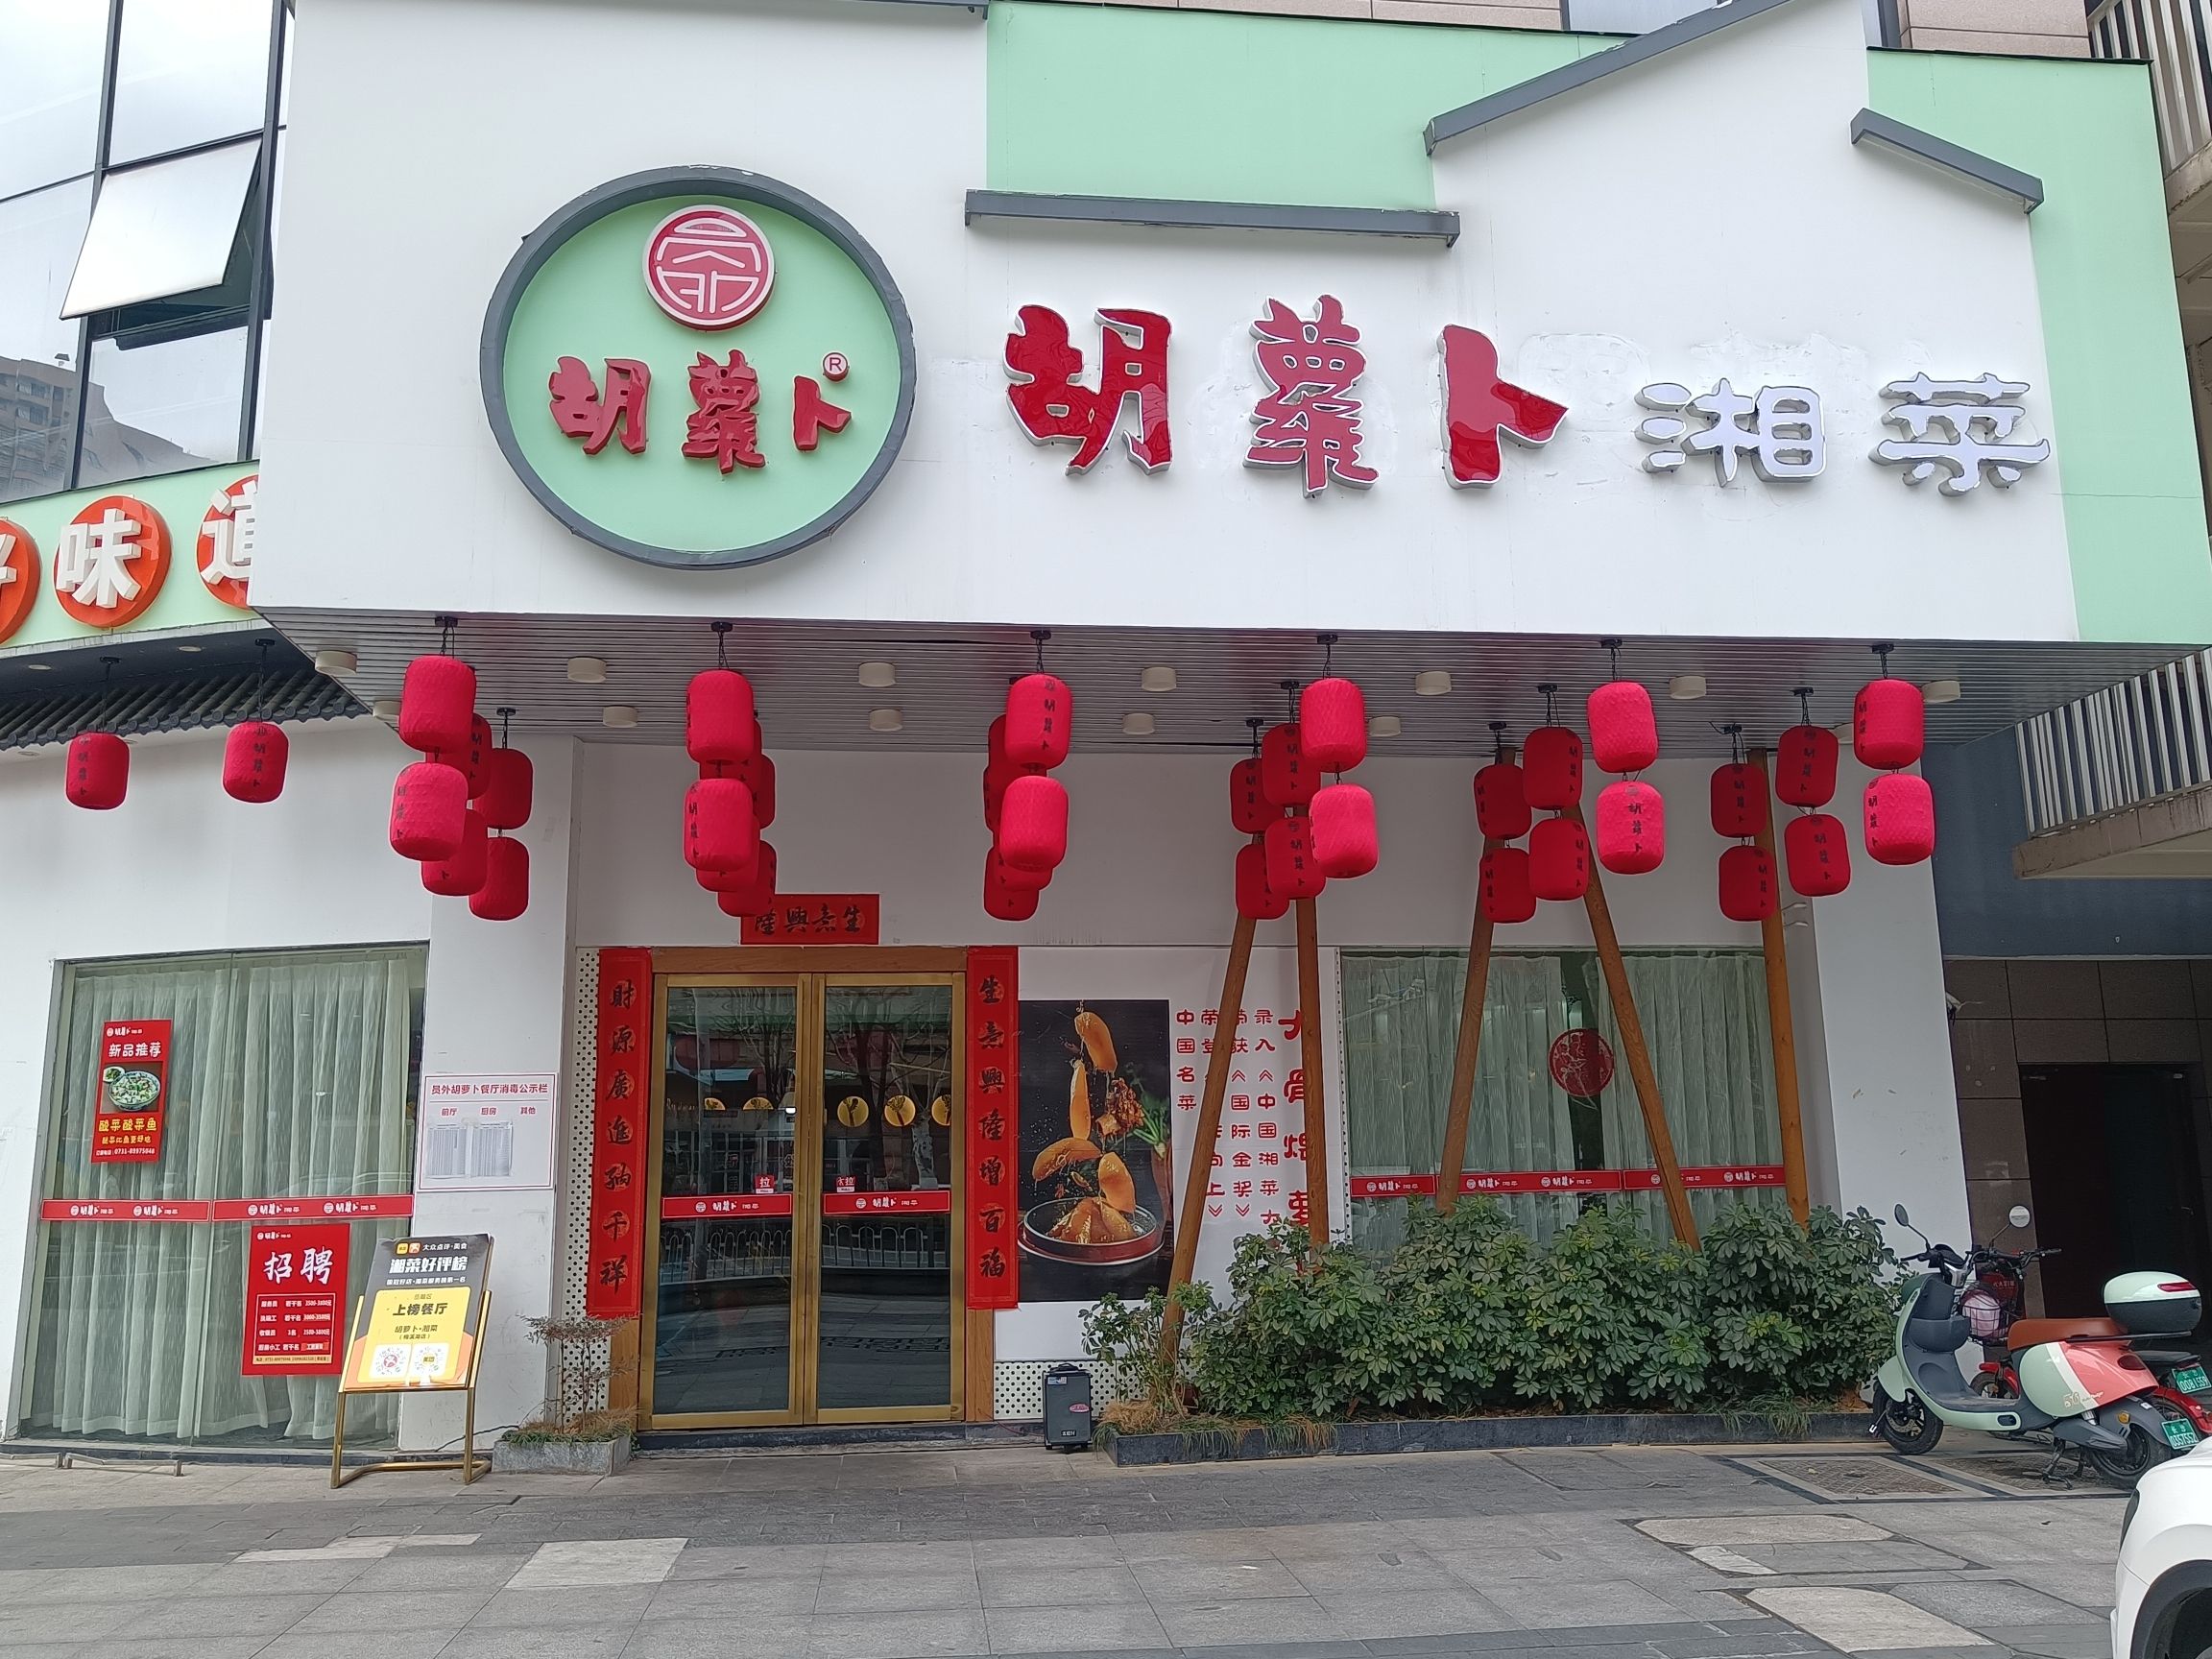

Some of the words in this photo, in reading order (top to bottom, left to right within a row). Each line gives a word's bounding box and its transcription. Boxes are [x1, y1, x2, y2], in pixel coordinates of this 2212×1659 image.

[1634, 372, 2050, 496] 湘菜
[108, 1042, 161, 1057] 新品推荐
[1176, 1009, 1196, 1111] 中国名菜
[431, 1083, 548, 1094] 员外胡萝卜餐厅消毒公示栏
[442, 1108, 458, 1117] 前厅
[481, 1107, 496, 1116] 厨房
[520, 1106, 536, 1115] 其他
[98, 1118, 156, 1132] 酸菜酸菜鱼
[759, 1177, 771, 1188] 拉
[263, 1246, 333, 1285] 招聘
[389, 1256, 468, 1274] 湘菜好评榜
[393, 1303, 447, 1316] 上榜餐厅
